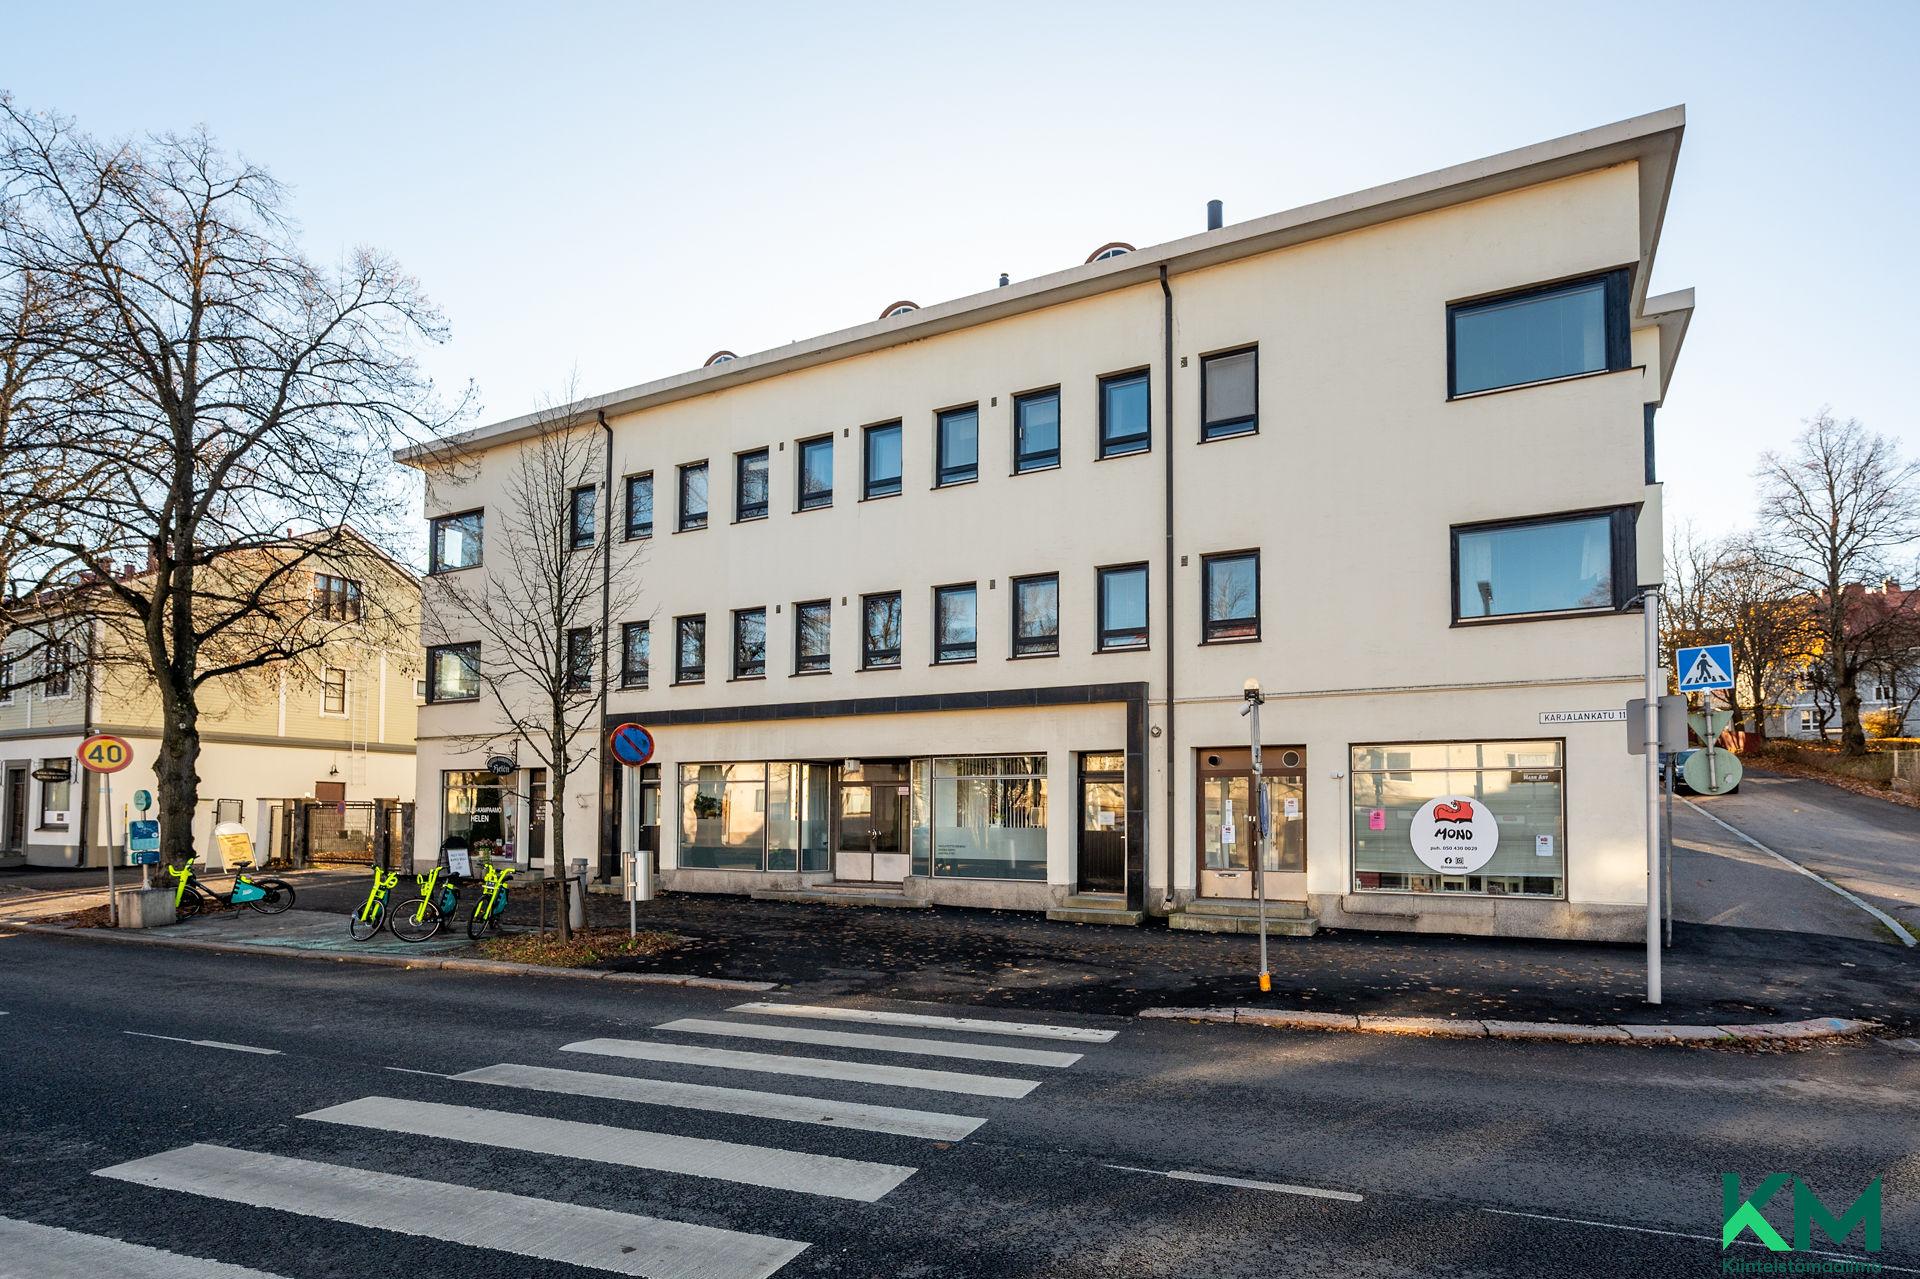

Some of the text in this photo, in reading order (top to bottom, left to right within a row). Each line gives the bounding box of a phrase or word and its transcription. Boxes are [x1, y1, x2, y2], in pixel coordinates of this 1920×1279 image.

[1544, 711, 1626, 721] KARJALANKATU 11
[88, 744, 122, 763] 40
[470, 814, 489, 822] HELEN
[1434, 827, 1473, 840] MOND
